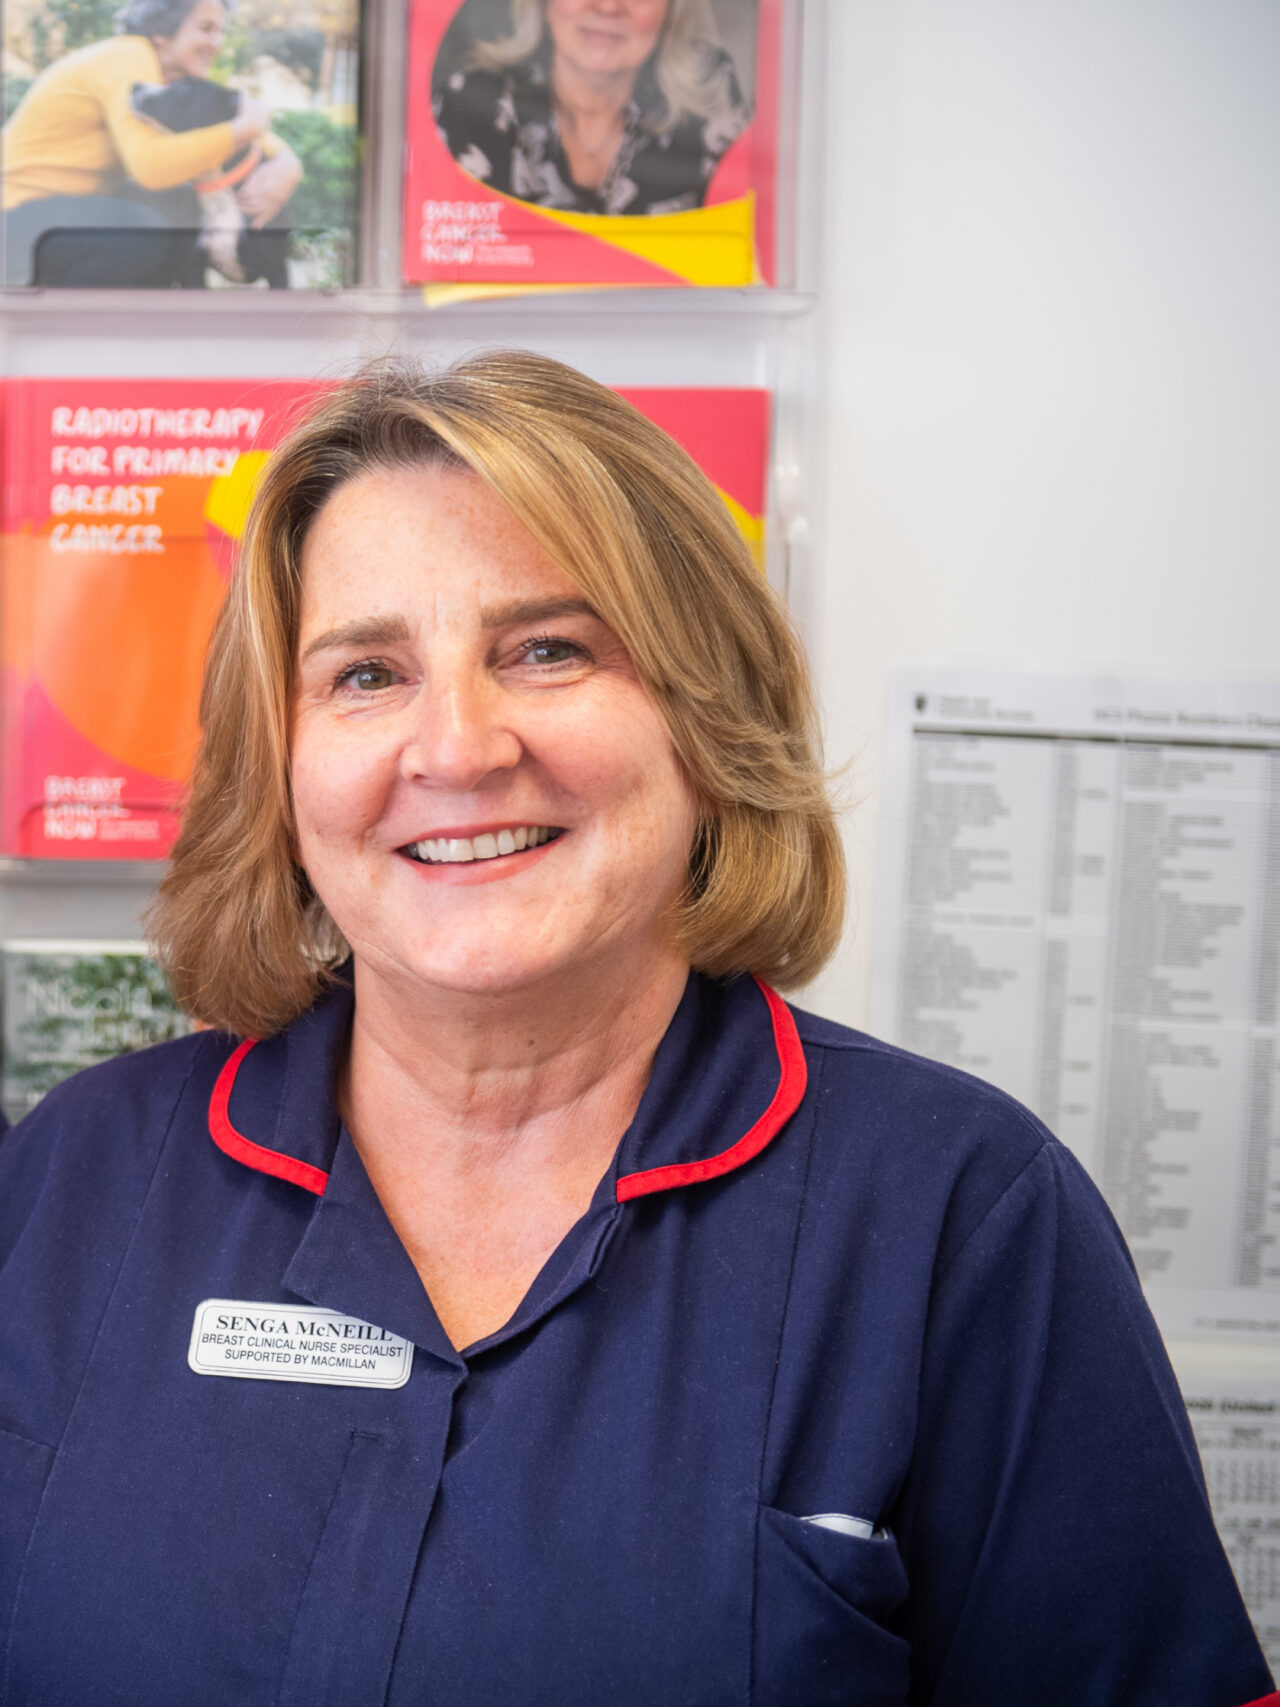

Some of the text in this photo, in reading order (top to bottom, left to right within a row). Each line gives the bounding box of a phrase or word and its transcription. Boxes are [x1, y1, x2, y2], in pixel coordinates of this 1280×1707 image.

[423, 201, 504, 221] BREAST
[421, 222, 508, 242] CANCER
[422, 243, 473, 264] NOW
[51, 407, 263, 438] RADIOTHERAPY
[51, 446, 239, 476] FOR PRIMARY
[50, 485, 162, 514] BREAST
[50, 524, 165, 554] CANCER
[216, 1314, 393, 1342] SENGA McNEILL
[202, 1333, 403, 1358] BREAST CLINICAL NURSE SPECIALIST
[225, 1349, 376, 1370] SUPPORTED BY MACMILLAN
